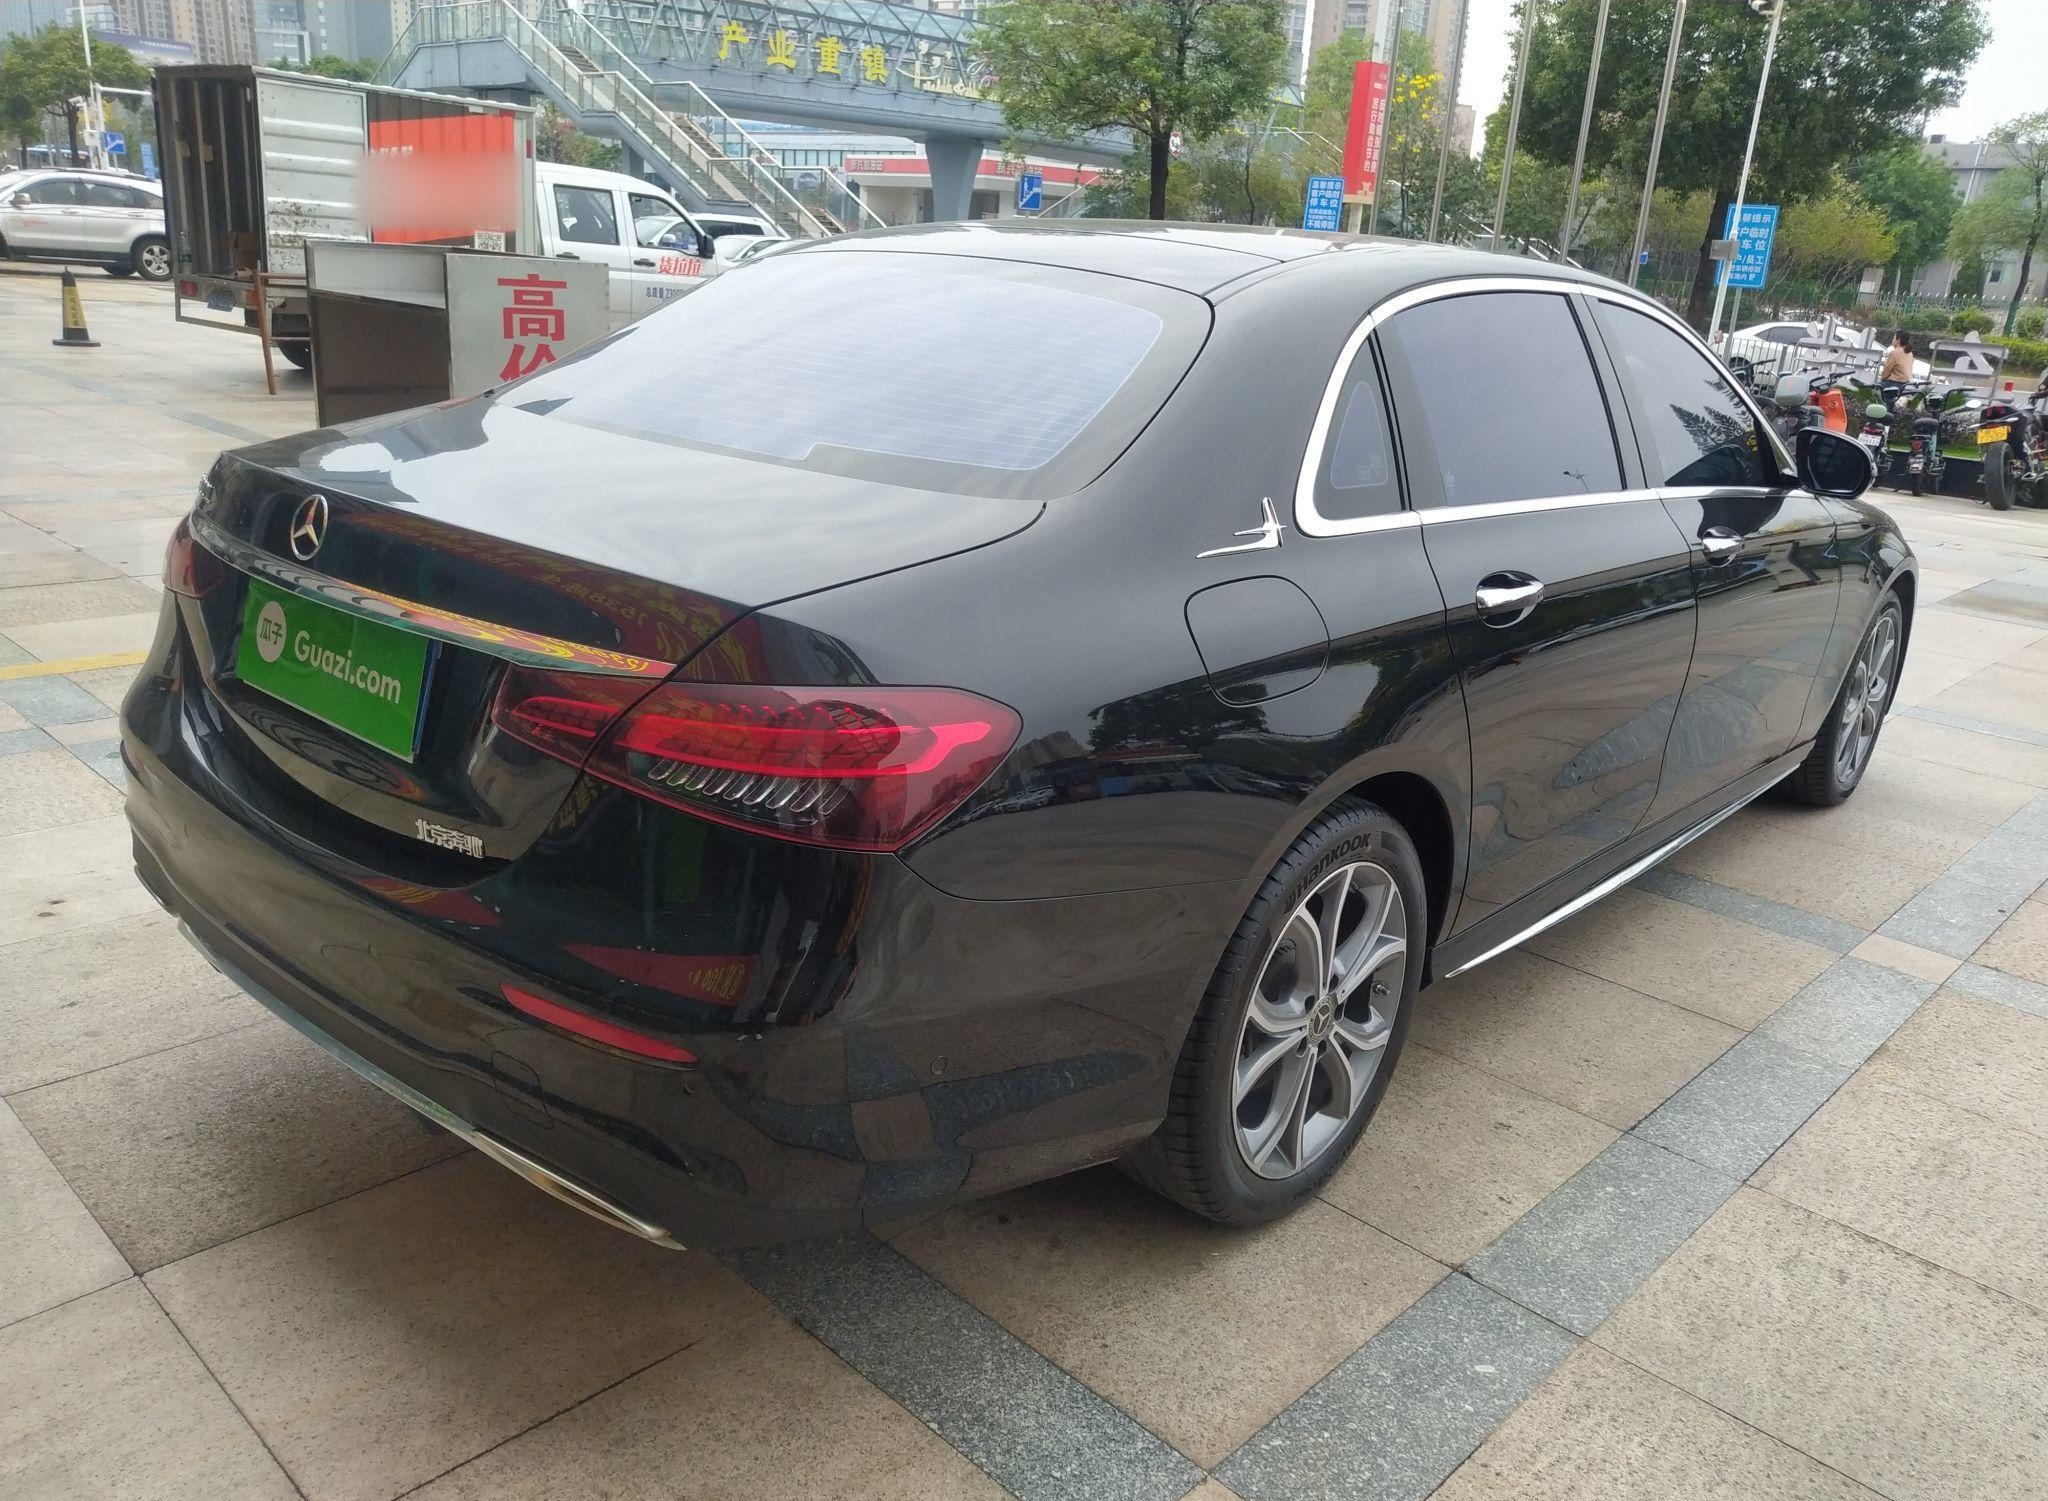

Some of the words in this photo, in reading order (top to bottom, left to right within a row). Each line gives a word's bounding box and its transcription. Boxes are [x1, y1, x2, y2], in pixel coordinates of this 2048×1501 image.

[718, 20, 889, 84] 产业重镇
[656, 256, 702, 277] 货拉拉
[259, 617, 283, 646] 瓜子
[294, 630, 401, 704] Guazi.com
[415, 819, 484, 858] 北京奔驰
